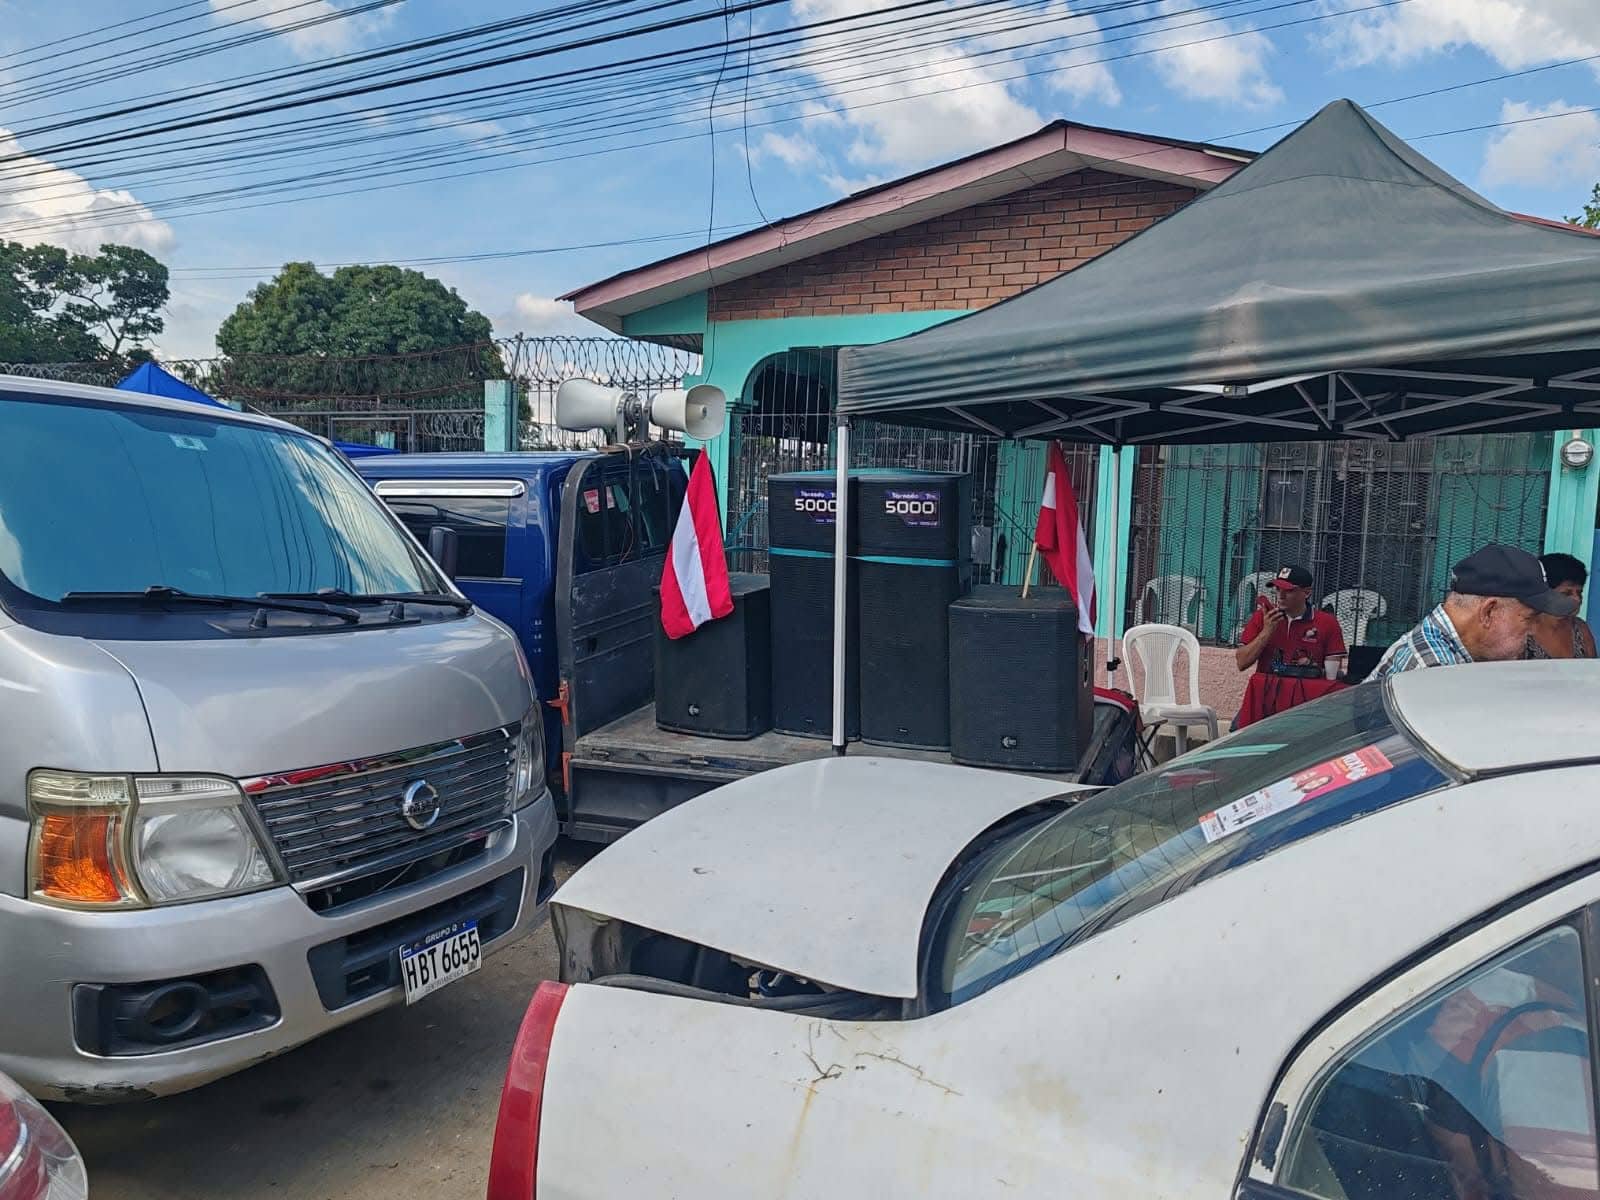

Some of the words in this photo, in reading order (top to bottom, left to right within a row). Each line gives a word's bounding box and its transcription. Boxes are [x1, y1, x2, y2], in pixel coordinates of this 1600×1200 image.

[794, 498, 838, 512] 5000
[885, 500, 935, 514] 5000
[425, 927, 451, 944] GRUPO
[404, 947, 437, 992] HBT
[442, 930, 480, 973] 6655
